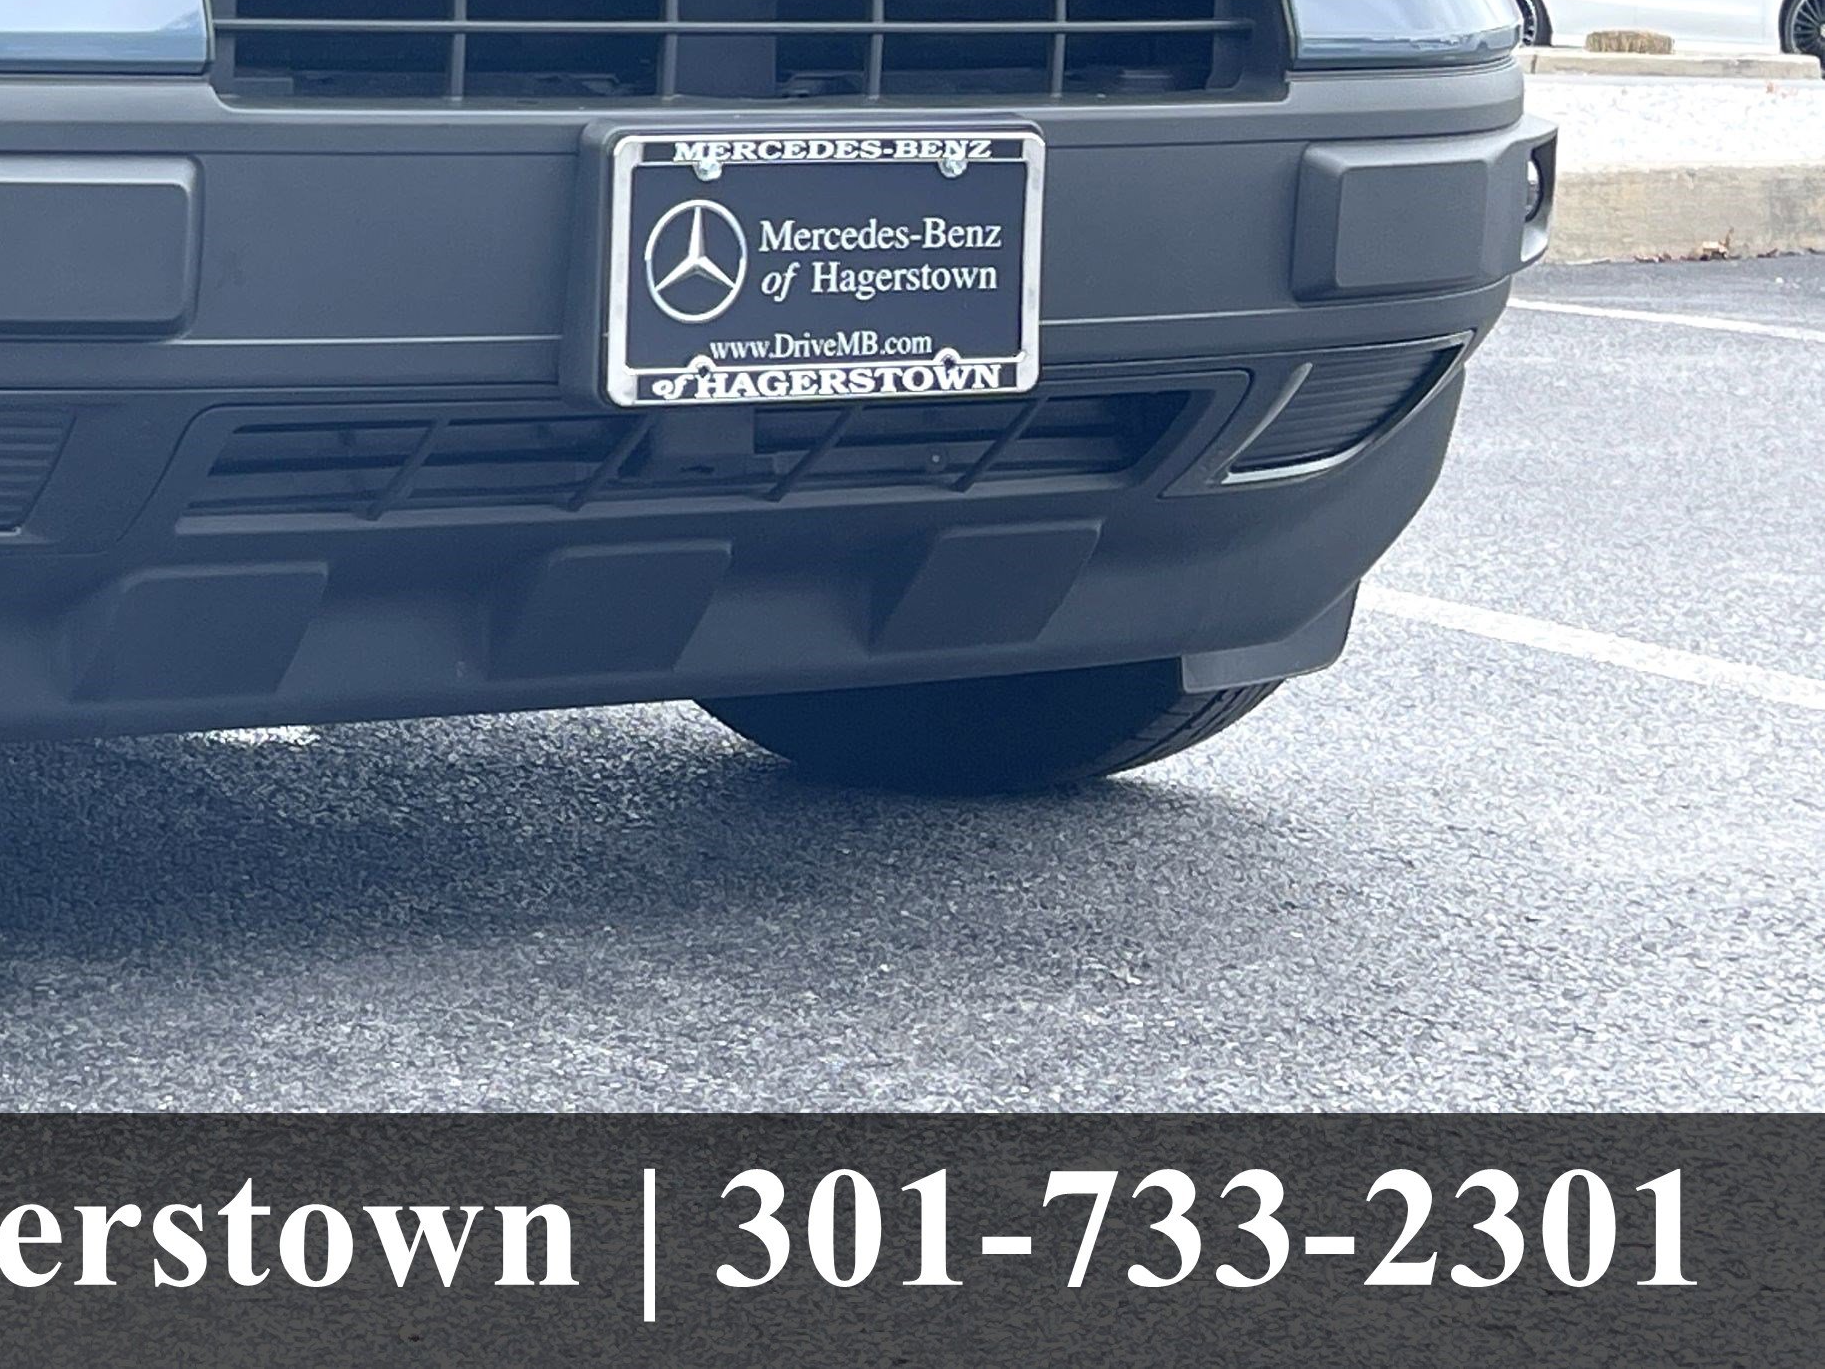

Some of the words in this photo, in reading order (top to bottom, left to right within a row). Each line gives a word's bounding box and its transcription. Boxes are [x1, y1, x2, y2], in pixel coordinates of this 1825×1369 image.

[673, 139, 993, 162] MERCEDES-BENZ
[757, 216, 1002, 253] Mercedes-Benz
[760, 262, 800, 302] of
[811, 261, 999, 300] Hagerstown
[709, 331, 933, 360] www.DriveMB.com
[651, 372, 694, 401] of
[694, 363, 1003, 401] HAGERSTOWN
